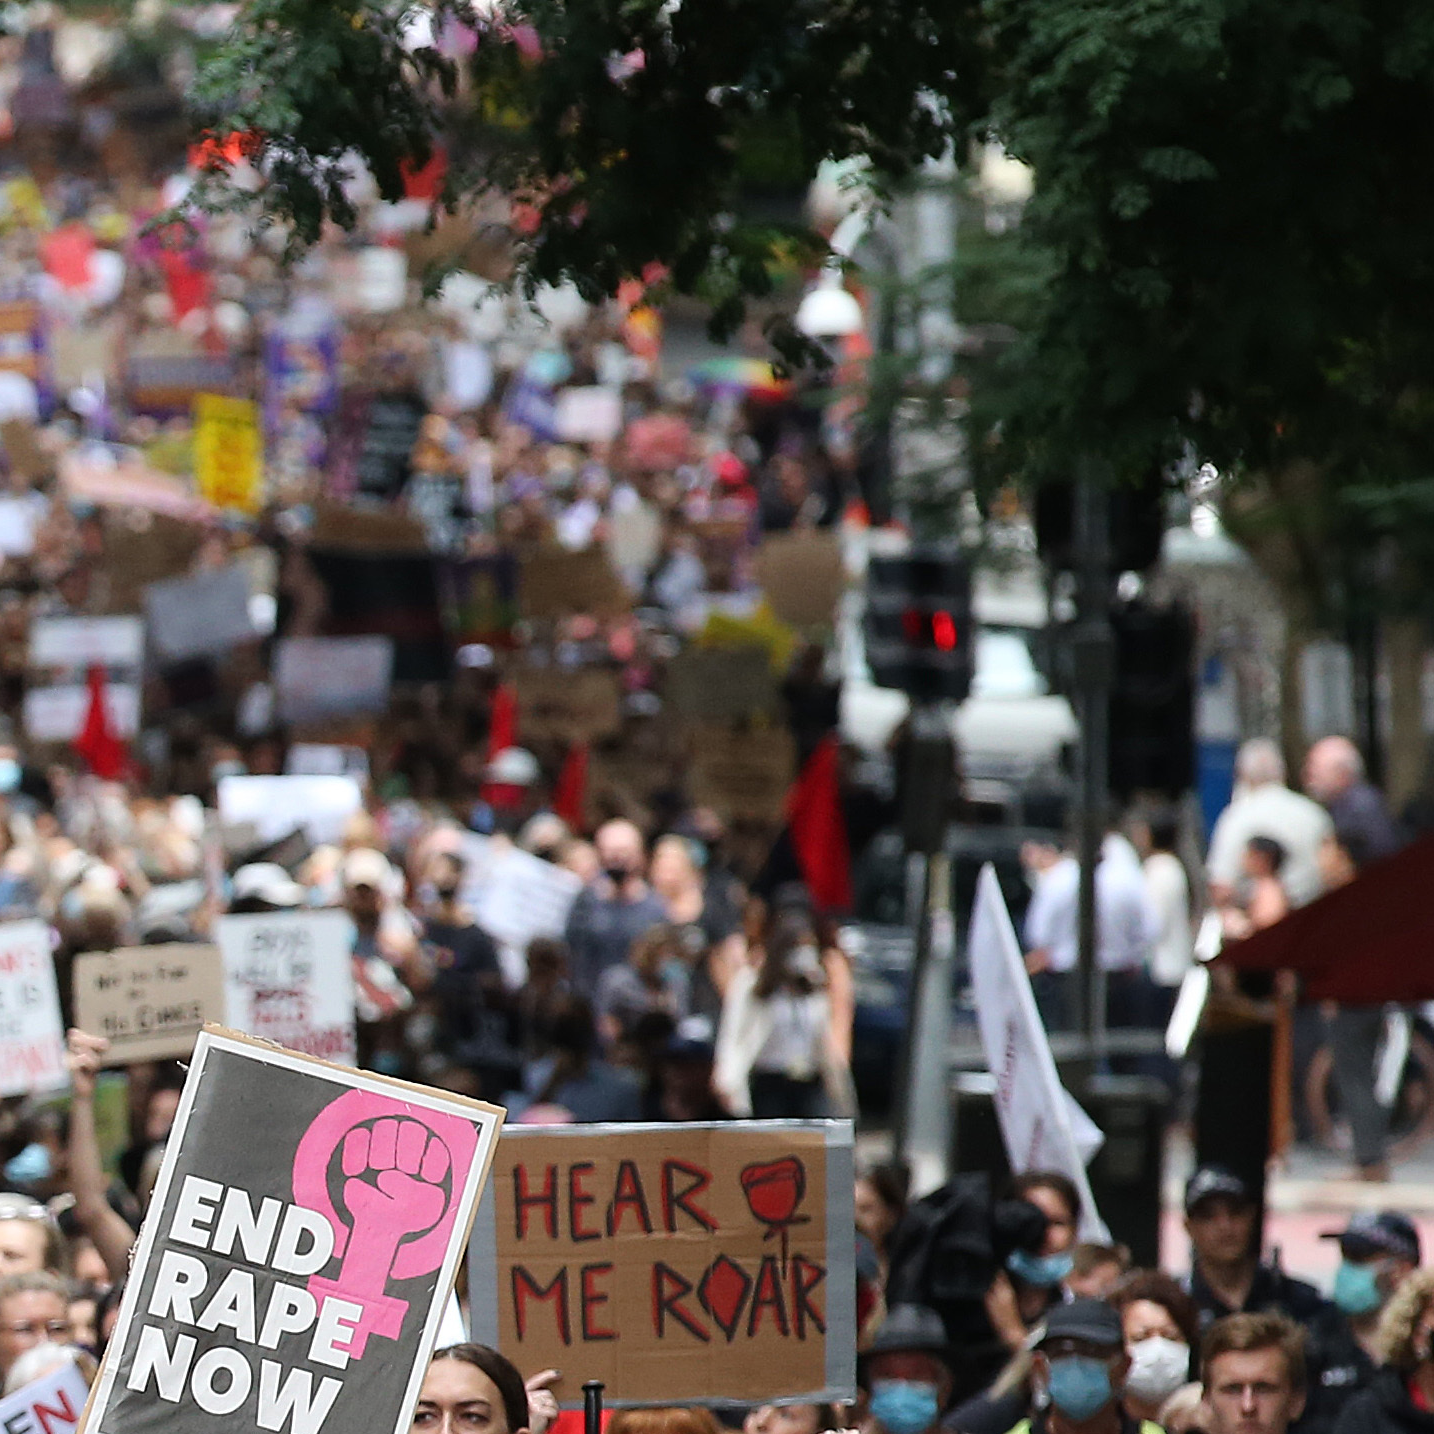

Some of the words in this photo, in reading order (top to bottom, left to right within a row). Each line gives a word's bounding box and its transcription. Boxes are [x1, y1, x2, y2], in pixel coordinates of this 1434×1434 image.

[169, 1174, 335, 1276] END
[512, 1158, 719, 1243] HEAR
[148, 1250, 364, 1370] RAPE
[509, 1264, 619, 1345] ME
[652, 1251, 827, 1344] ROAR
